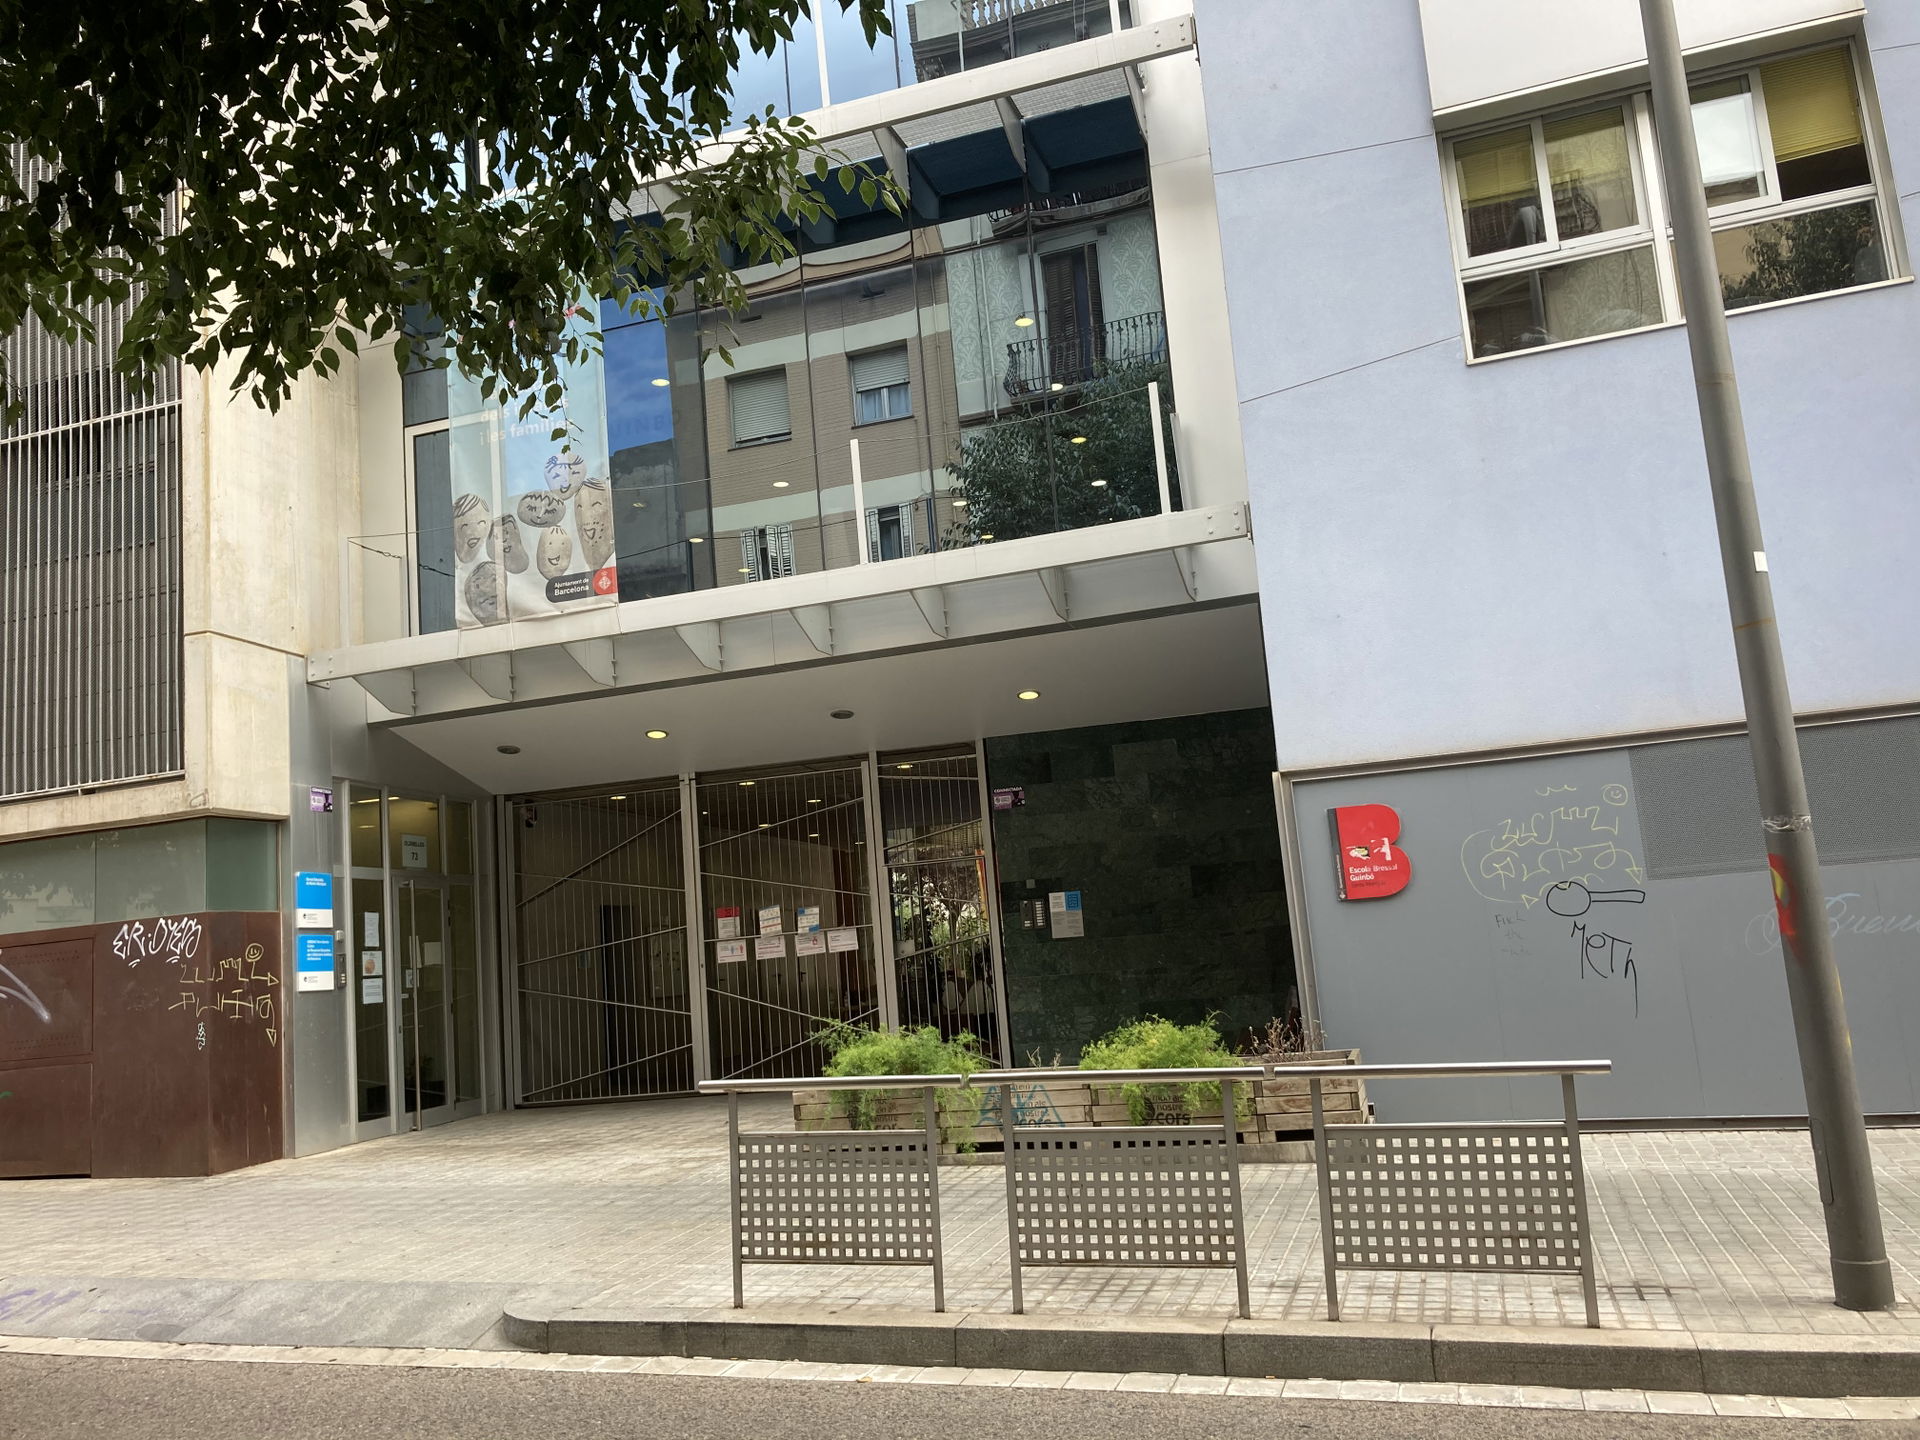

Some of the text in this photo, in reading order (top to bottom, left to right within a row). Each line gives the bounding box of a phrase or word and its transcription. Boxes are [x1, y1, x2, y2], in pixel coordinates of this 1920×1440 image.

[554, 579, 582, 589] Ajuntament
[554, 585, 590, 596] Barcelona
[1349, 865, 1371, 874] Escola
[1156, 1112, 1191, 1126] cors
